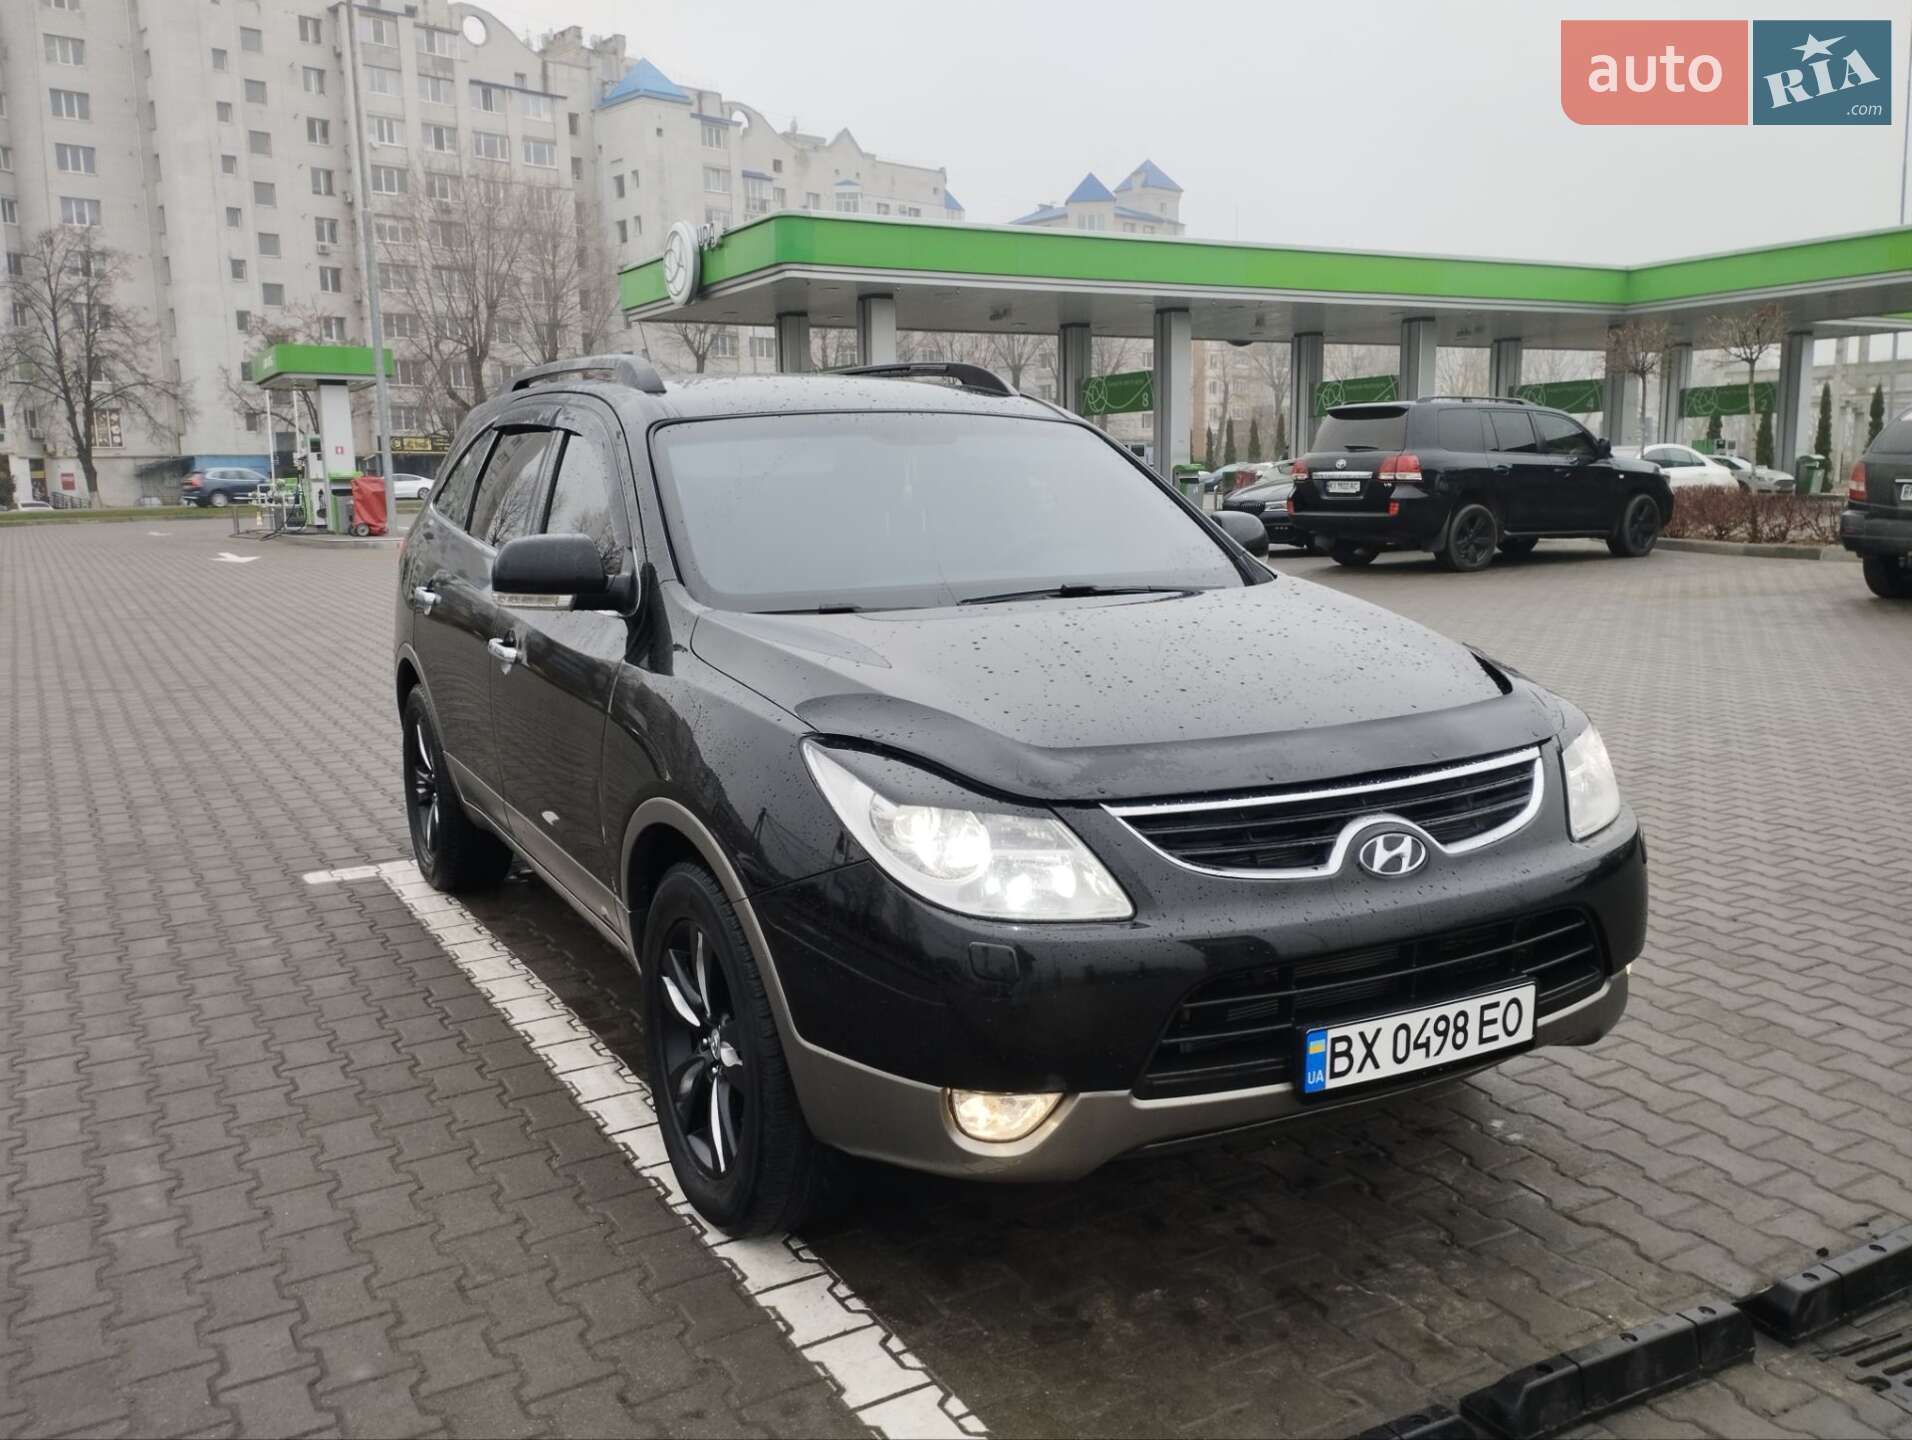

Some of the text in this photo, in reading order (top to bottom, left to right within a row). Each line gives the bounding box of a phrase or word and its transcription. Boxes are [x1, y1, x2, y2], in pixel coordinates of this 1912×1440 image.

[1142, 391, 1150, 408] 8
[1328, 997, 1523, 1080] BX 0498 EO
[1307, 1069, 1324, 1084] UA
